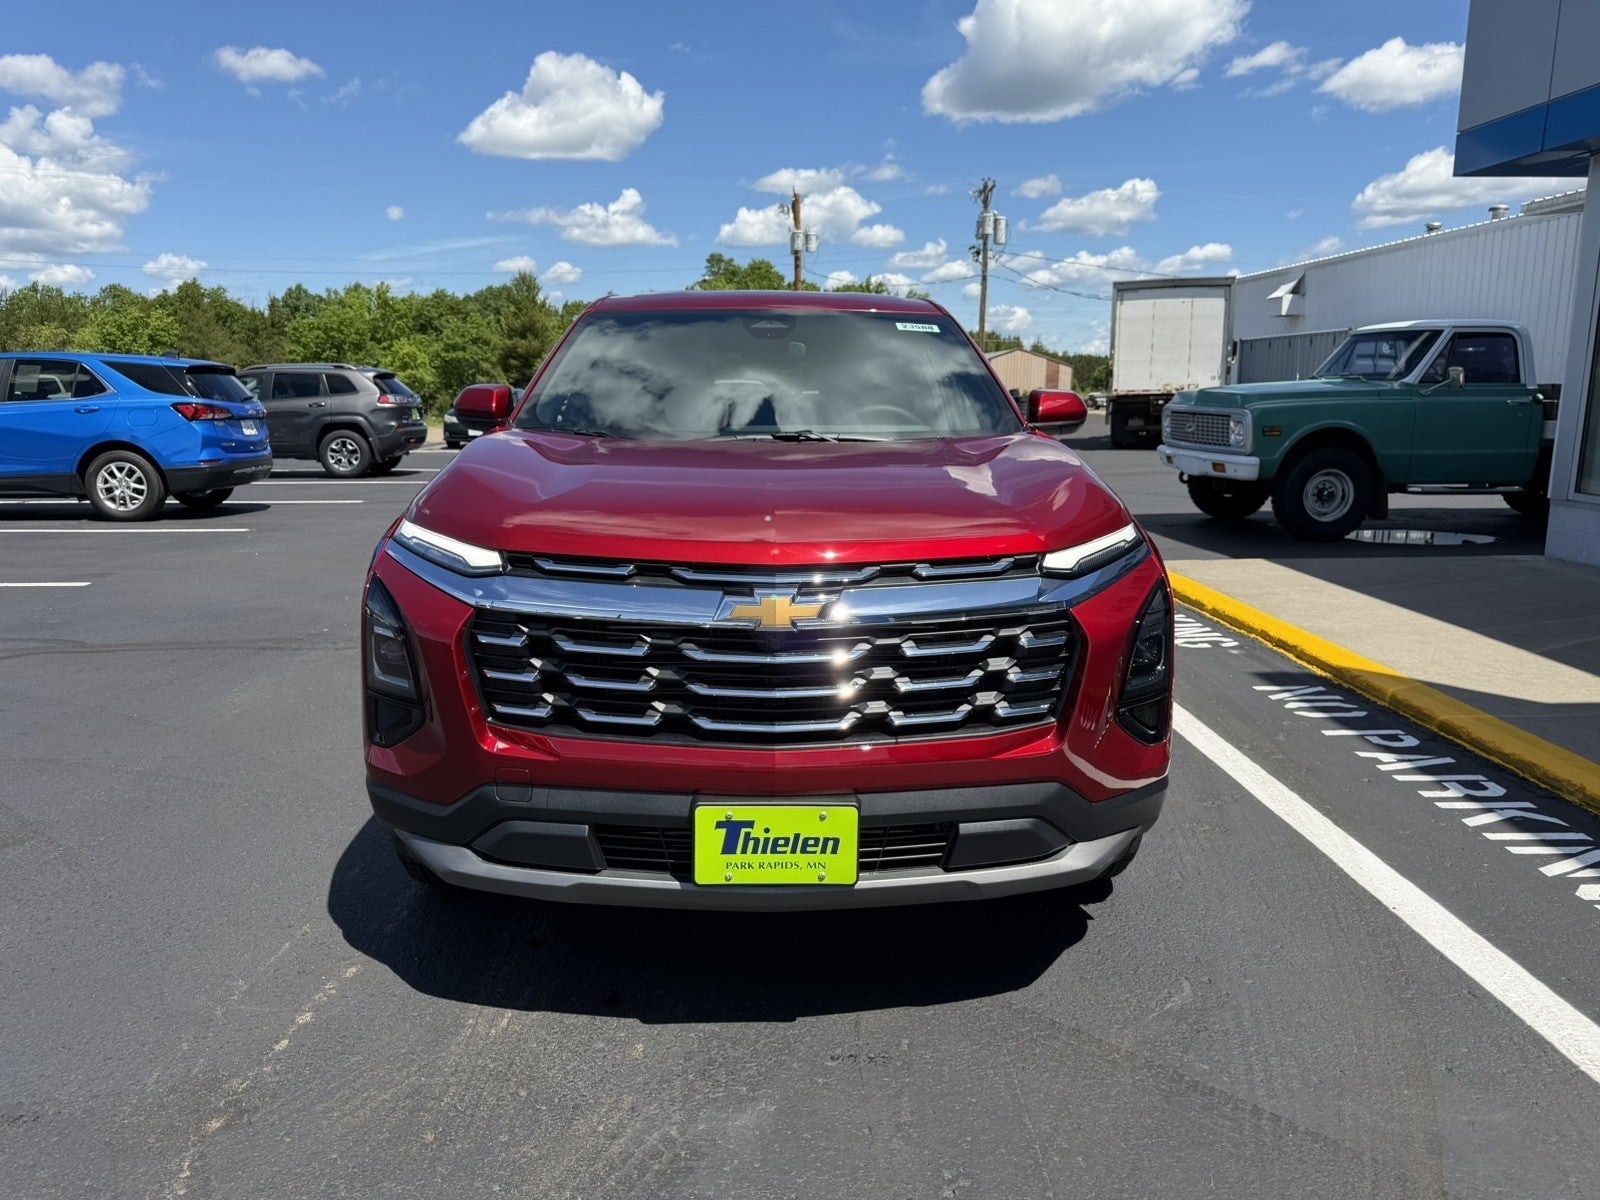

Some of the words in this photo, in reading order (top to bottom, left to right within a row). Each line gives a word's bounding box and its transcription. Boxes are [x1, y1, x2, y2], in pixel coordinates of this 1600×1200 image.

[1252, 685, 1368, 718] NO
[1321, 729, 1600, 912] PARKIN
[714, 820, 841, 855] Thielen
[725, 861, 754, 870] PARK
[758, 861, 803, 871] RAPIDS,
[806, 861, 827, 870] MN
